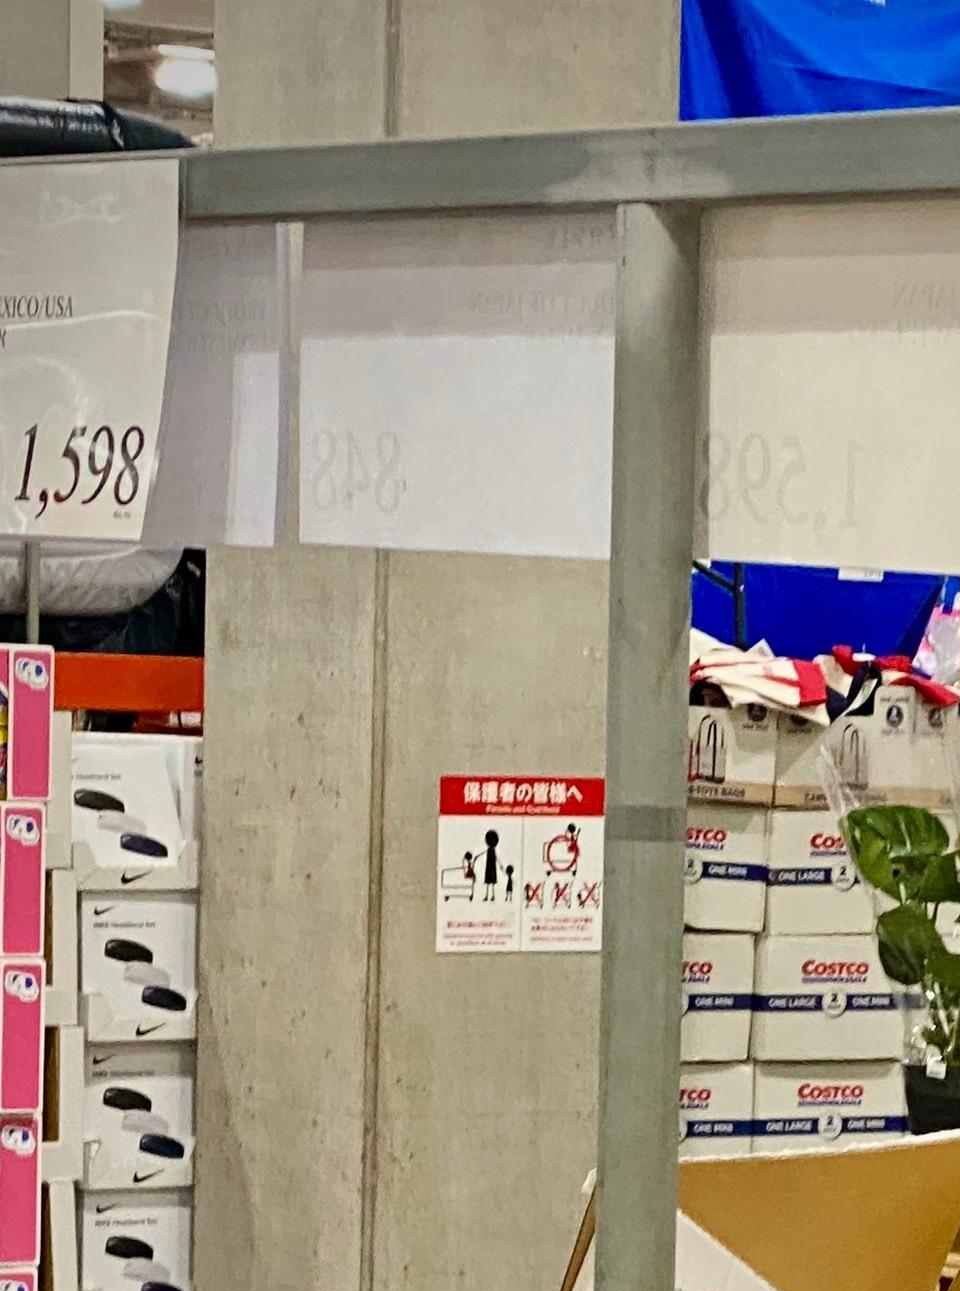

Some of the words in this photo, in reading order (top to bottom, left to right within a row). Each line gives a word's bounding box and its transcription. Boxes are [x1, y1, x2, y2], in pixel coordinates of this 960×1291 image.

[14, 422, 146, 520] 1,598
[801, 960, 870, 976] COSTCO
[831, 993, 838, 1003] 2
[798, 1083, 864, 1099] COSTCO
[827, 1115, 834, 1125] 2
